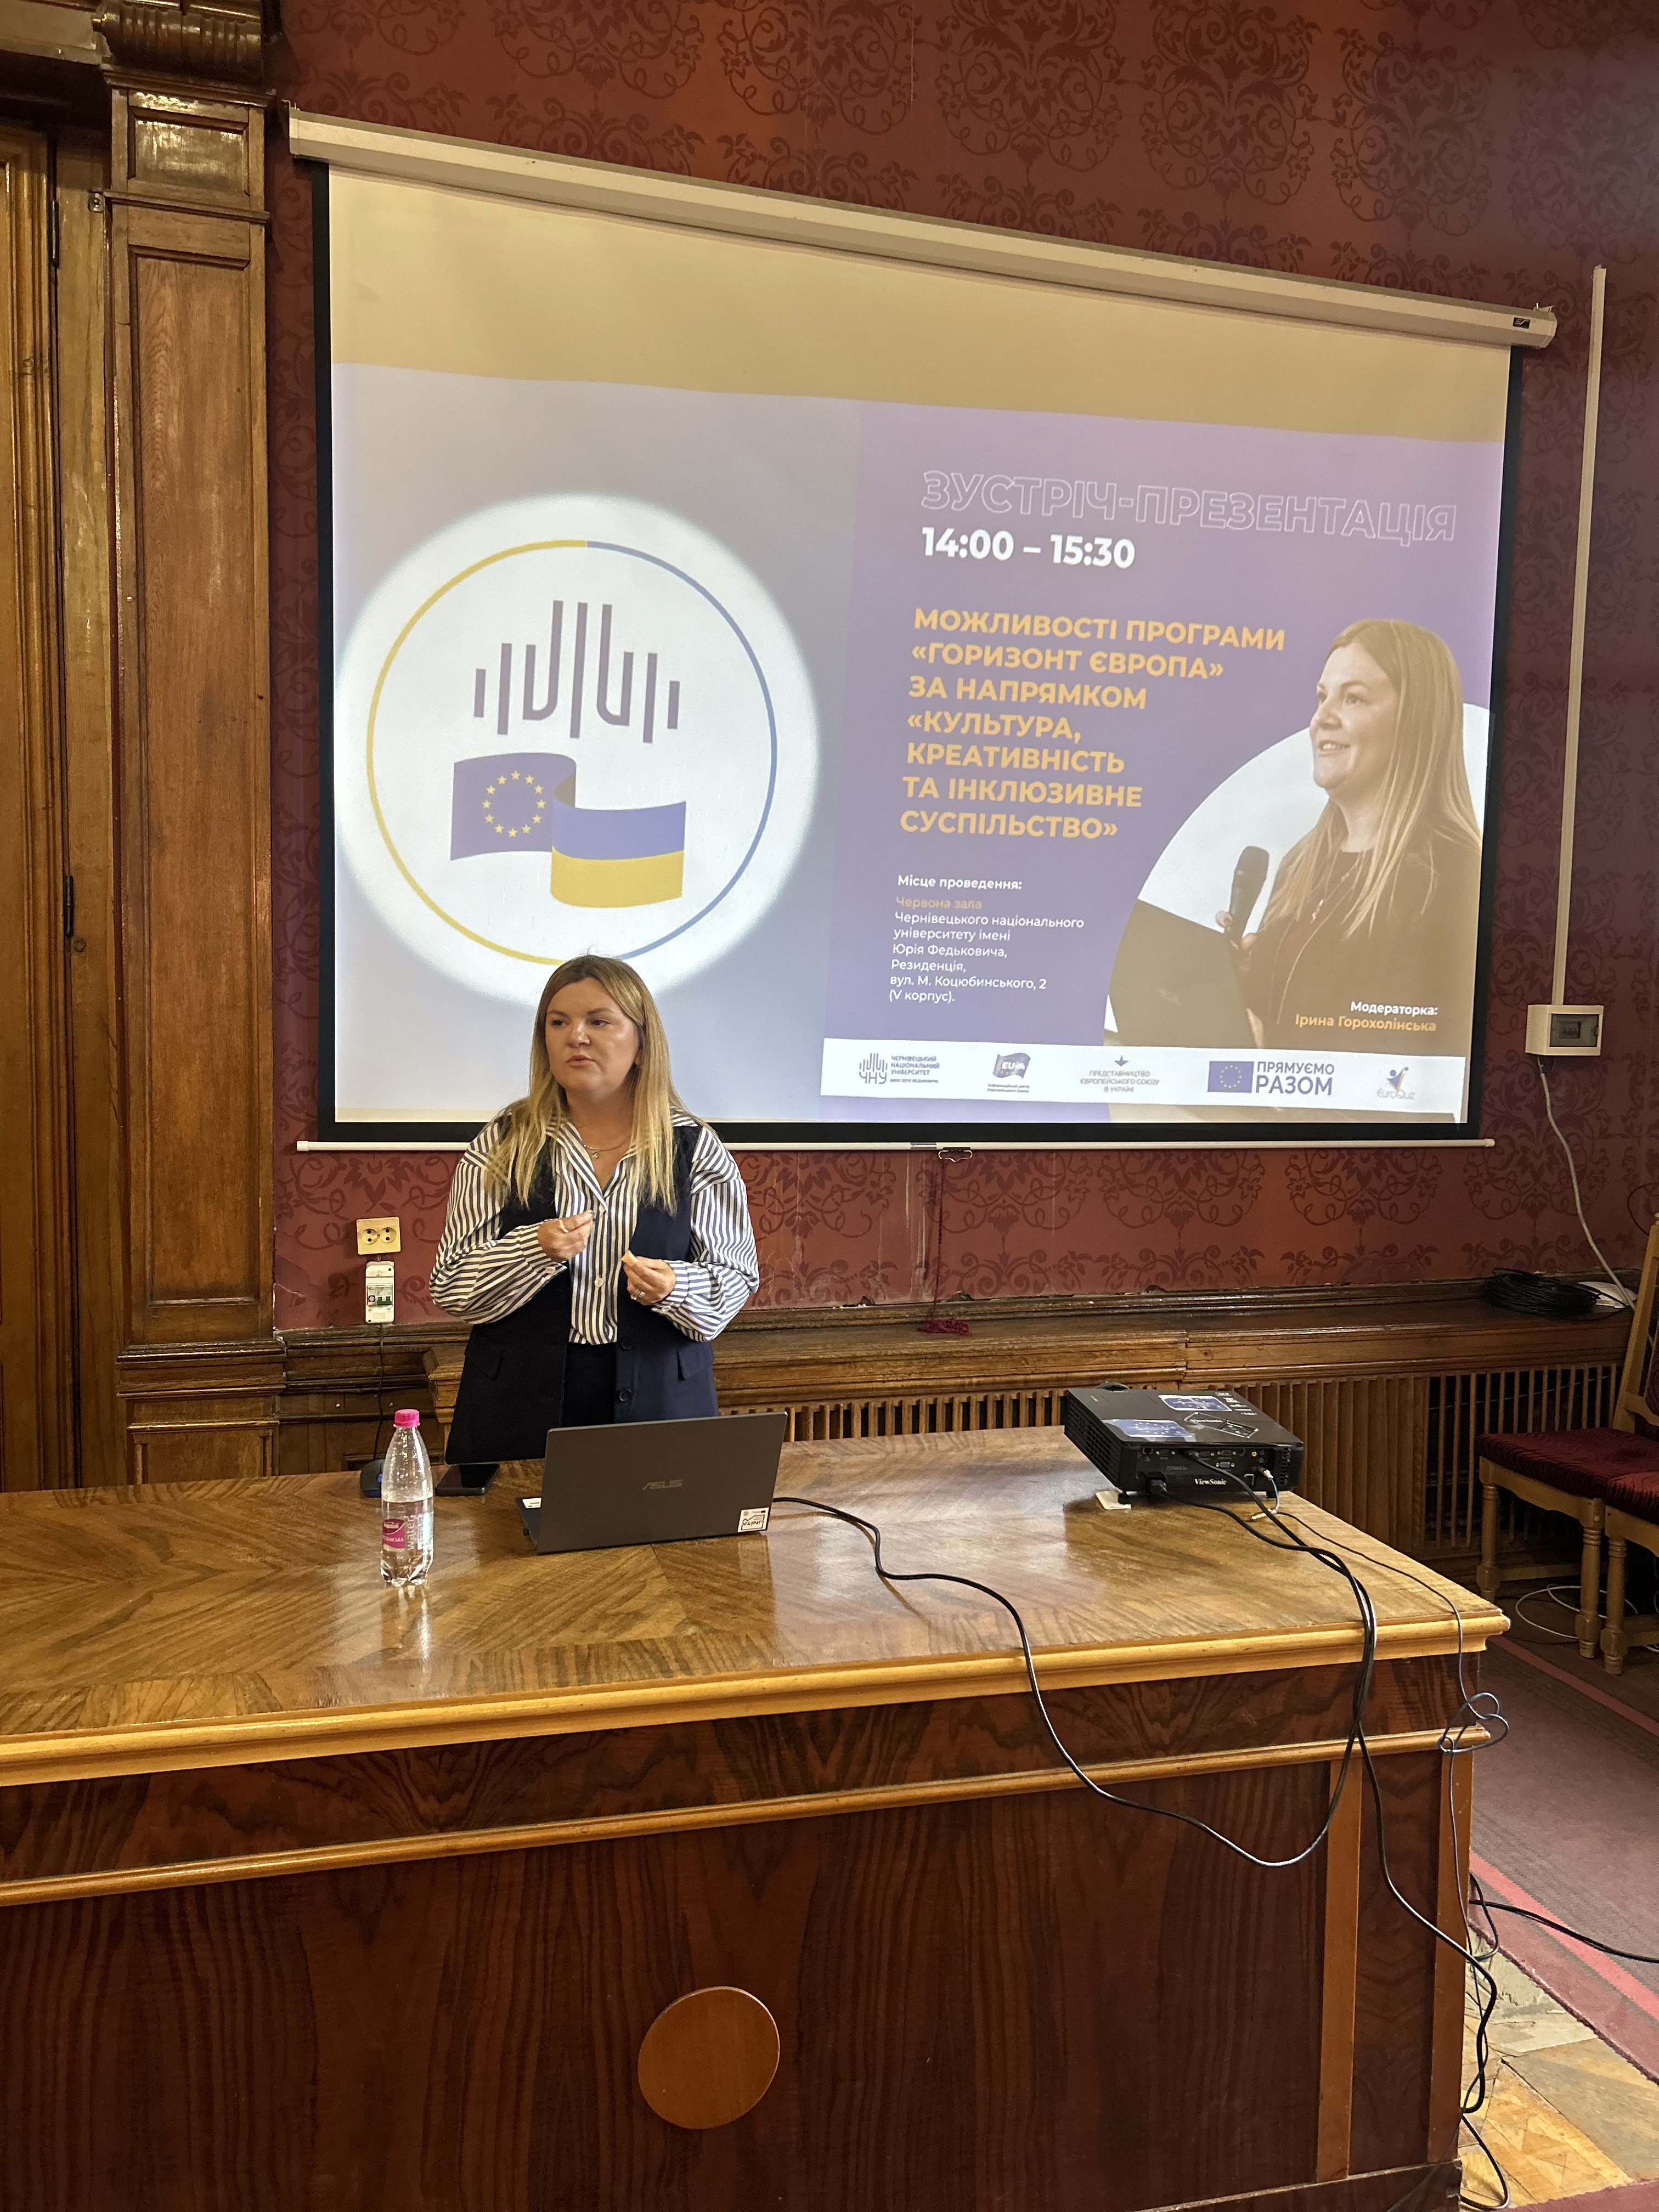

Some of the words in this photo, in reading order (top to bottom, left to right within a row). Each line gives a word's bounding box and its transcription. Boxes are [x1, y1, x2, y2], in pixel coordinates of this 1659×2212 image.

[921, 470, 1457, 546] ЗУСТРІЧ-ПРЕЗЕНТАЦІЯ
[922, 527, 1014, 561] 14:00
[1050, 534, 1135, 568] 15:30
[914, 608, 1118, 640] МОЖЛИВОСТІ
[1126, 619, 1285, 651] ПРОГРАМИ
[912, 642, 1082, 671] «ГОРИЗОНТ
[1089, 651, 1224, 679] ЄВРОПА»
[909, 675, 947, 699] ЗА
[956, 678, 1147, 709] НАПРЯМКОМ
[907, 710, 1081, 743] «КУЛЬТУРА,
[907, 742, 1125, 773] КРЕАТИВНІСТЬ
[902, 776, 939, 798] ТА
[949, 778, 1143, 807] ІНКЛЮЗИВНЕ
[900, 810, 1118, 839] СУСПІЛЬСТВО»
[898, 874, 935, 888] Місце
[939, 878, 1022, 890] проведення:
[896, 896, 950, 909] Червона
[954, 900, 983, 909] зала
[895, 912, 988, 926] Чернівецького
[992, 915, 1084, 928] національного
[893, 927, 976, 942] університету
[979, 929, 1011, 940] імені
[893, 944, 924, 956] Юрія
[927, 945, 1007, 958] Федьковича,
[891, 959, 966, 973] Резиденція,
[890, 976, 914, 987] вул.
[917, 975, 932, 986] М.
[935, 976, 1036, 990] Коцюбинського,
[1039, 979, 1047, 989] 2
[889, 989, 902, 1002] (V
[904, 991, 955, 1003] корпус).
[1350, 1001, 1439, 1017] Модераторка:
[1295, 1014, 1334, 1028] Ірина
[1338, 1015, 1436, 1031] Горохолінська
[1257, 1060, 1335, 1075] ПРЯМУЄМО
[859, 1071, 887, 1085] ЧНУ
[1255, 1074, 1333, 1096] РАЗОМ
[641, 1479, 683, 1491] ASUS
